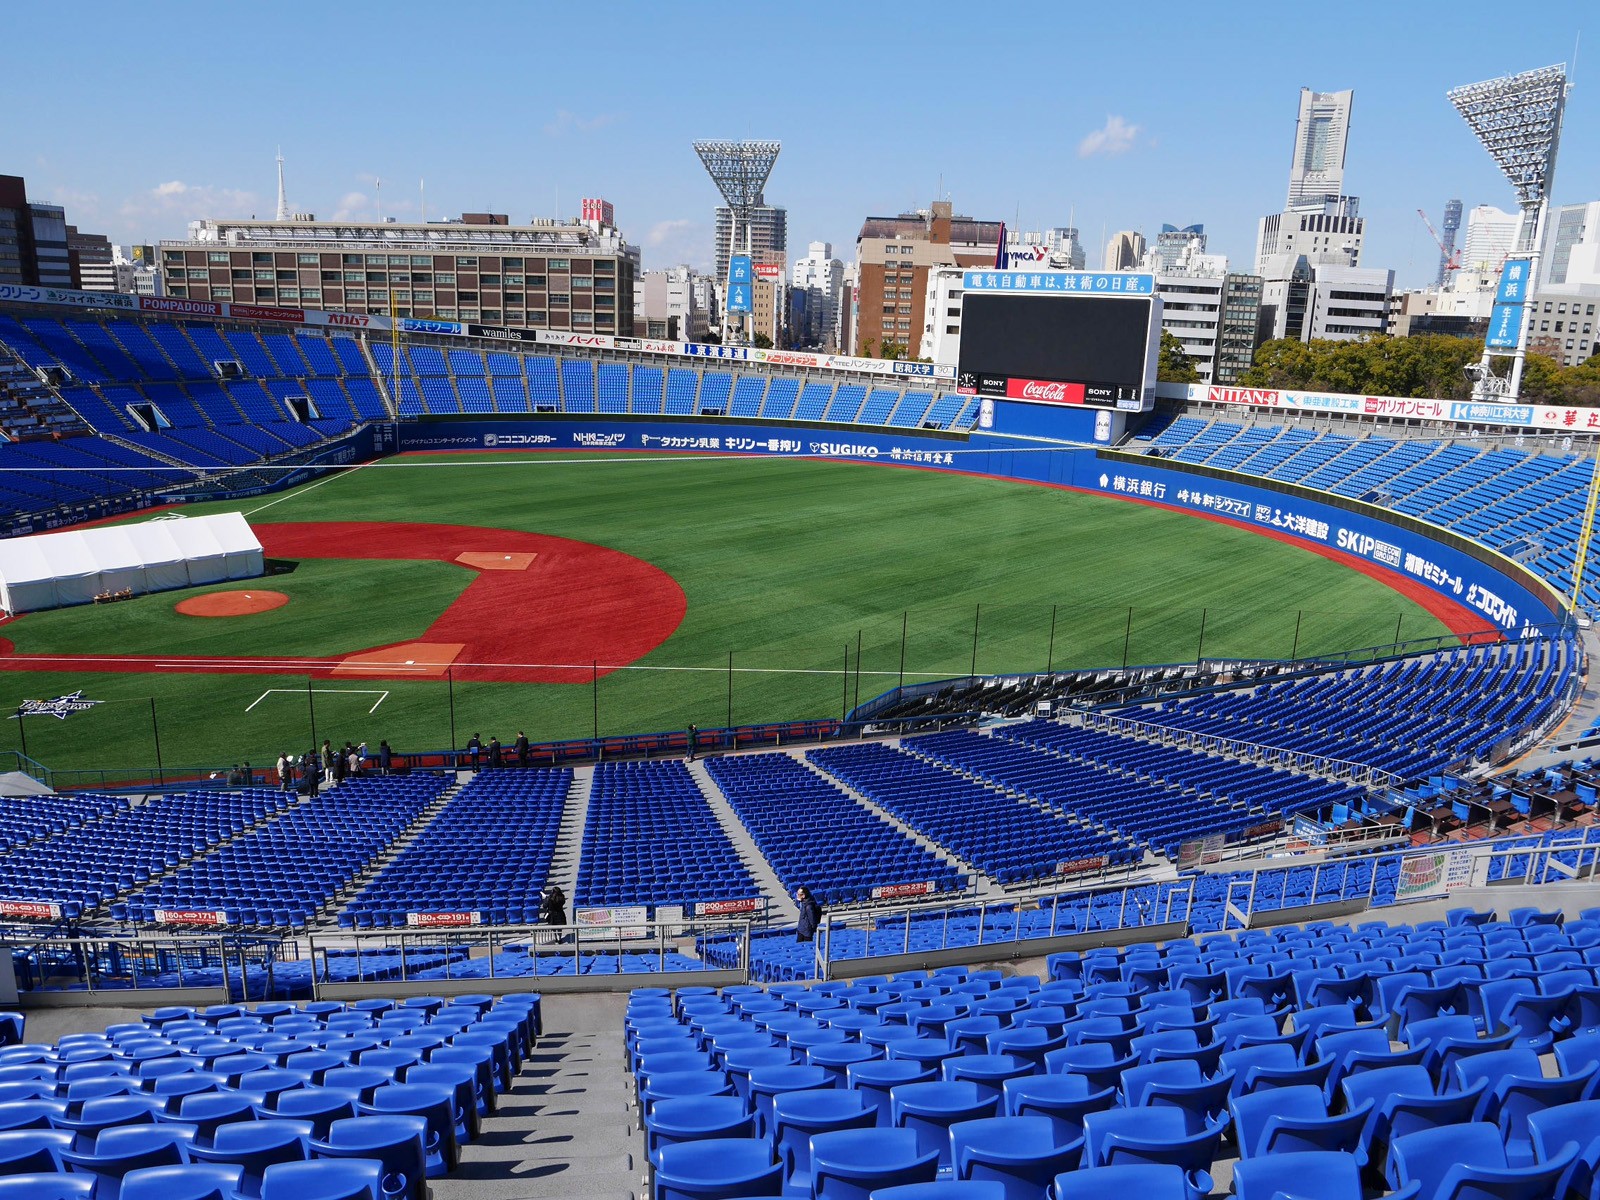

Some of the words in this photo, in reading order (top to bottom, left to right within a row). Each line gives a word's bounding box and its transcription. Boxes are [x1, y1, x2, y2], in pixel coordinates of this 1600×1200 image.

[1009, 252, 1035, 261] YMCA
[971, 274, 1145, 292] 電気自動車は、技術の日産。
[0, 286, 40, 300] クリーン
[58, 294, 134, 308] ジョイホース横浜
[143, 300, 216, 314] POMPADOUR
[328, 313, 370, 327] オカムラ
[413, 322, 462, 334] メモワール
[482, 328, 522, 340] wamiles
[850, 360, 886, 370] バンテック
[894, 362, 931, 375] 昭和大学
[983, 379, 1005, 387] SONY
[1022, 381, 1068, 401] Coca-Cola
[1088, 388, 1112, 396] SONY
[1209, 387, 1264, 405] NITTAN
[1303, 395, 1360, 409] 東亜建設工業
[1377, 400, 1443, 417] オリオンビール
[1469, 405, 1530, 420] 神奈川工科大学
[498, 434, 557, 444] ニコニコレンタカー
[660, 436, 720, 449] タカナシ乳業
[725, 437, 801, 452] キリン一番搾り
[820, 442, 879, 458] SUGIKO
[890, 447, 954, 465] 横浜信用金庫
[1113, 475, 1166, 499] 横浜銀行
[1216, 496, 1250, 516] シウマイ
[1284, 513, 1329, 540] 大洋建設
[1336, 528, 1374, 555] SKiP
[1404, 552, 1463, 594] 湘南ゼミナール
[1476, 586, 1518, 629] コロワイド
